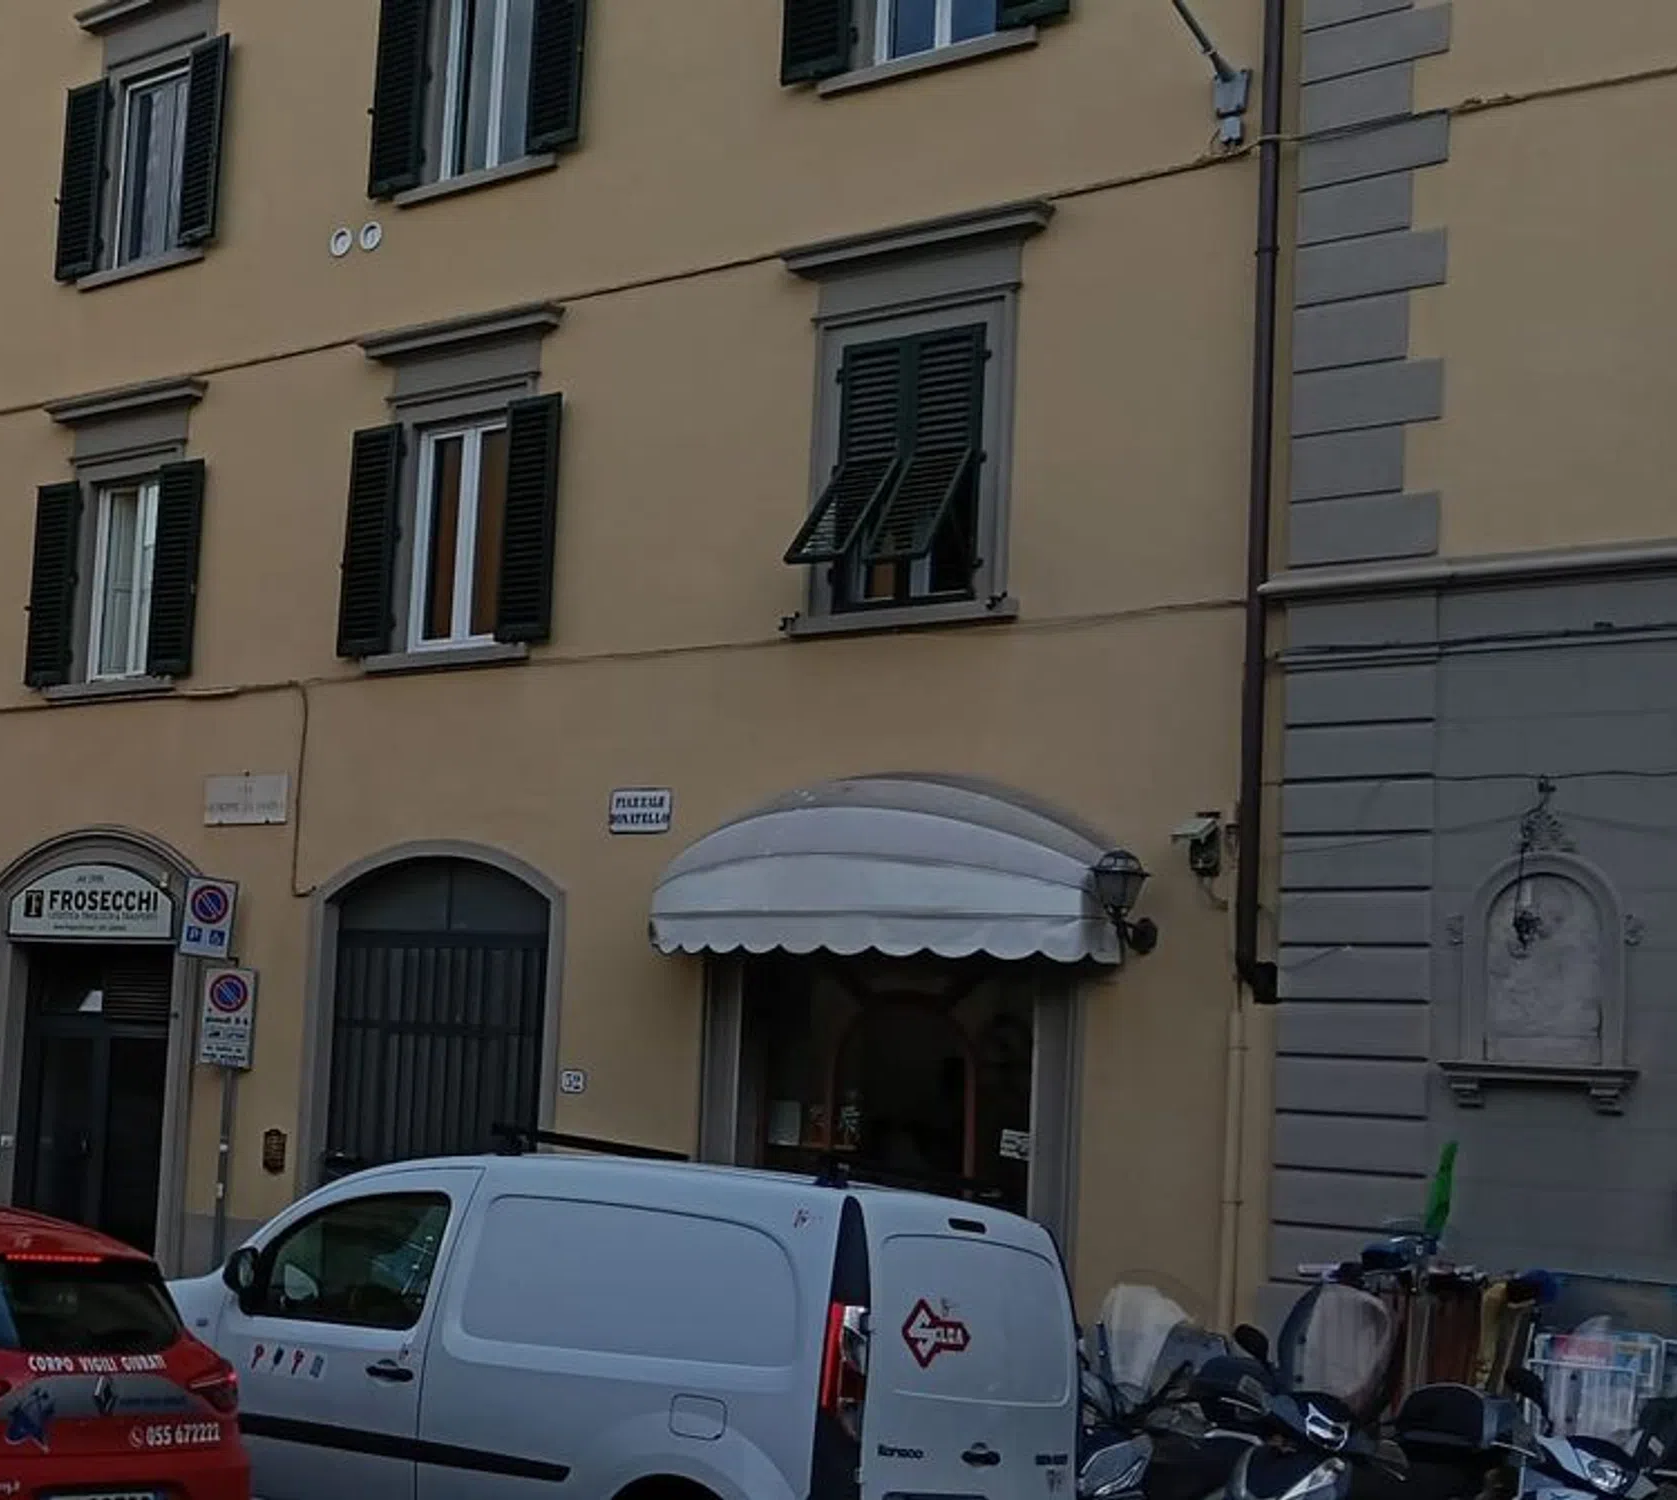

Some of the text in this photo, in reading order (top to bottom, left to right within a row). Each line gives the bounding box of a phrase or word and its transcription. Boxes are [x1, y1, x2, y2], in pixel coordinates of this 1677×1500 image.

[615, 795, 665, 808] PIAZZALE
[609, 812, 670, 825] DONATELLO
[49, 889, 158, 912] FROSECCHI
[27, 1354, 168, 1372] CORPO VIGILI GIURATI
[145, 1423, 221, 1446] 055 672222
